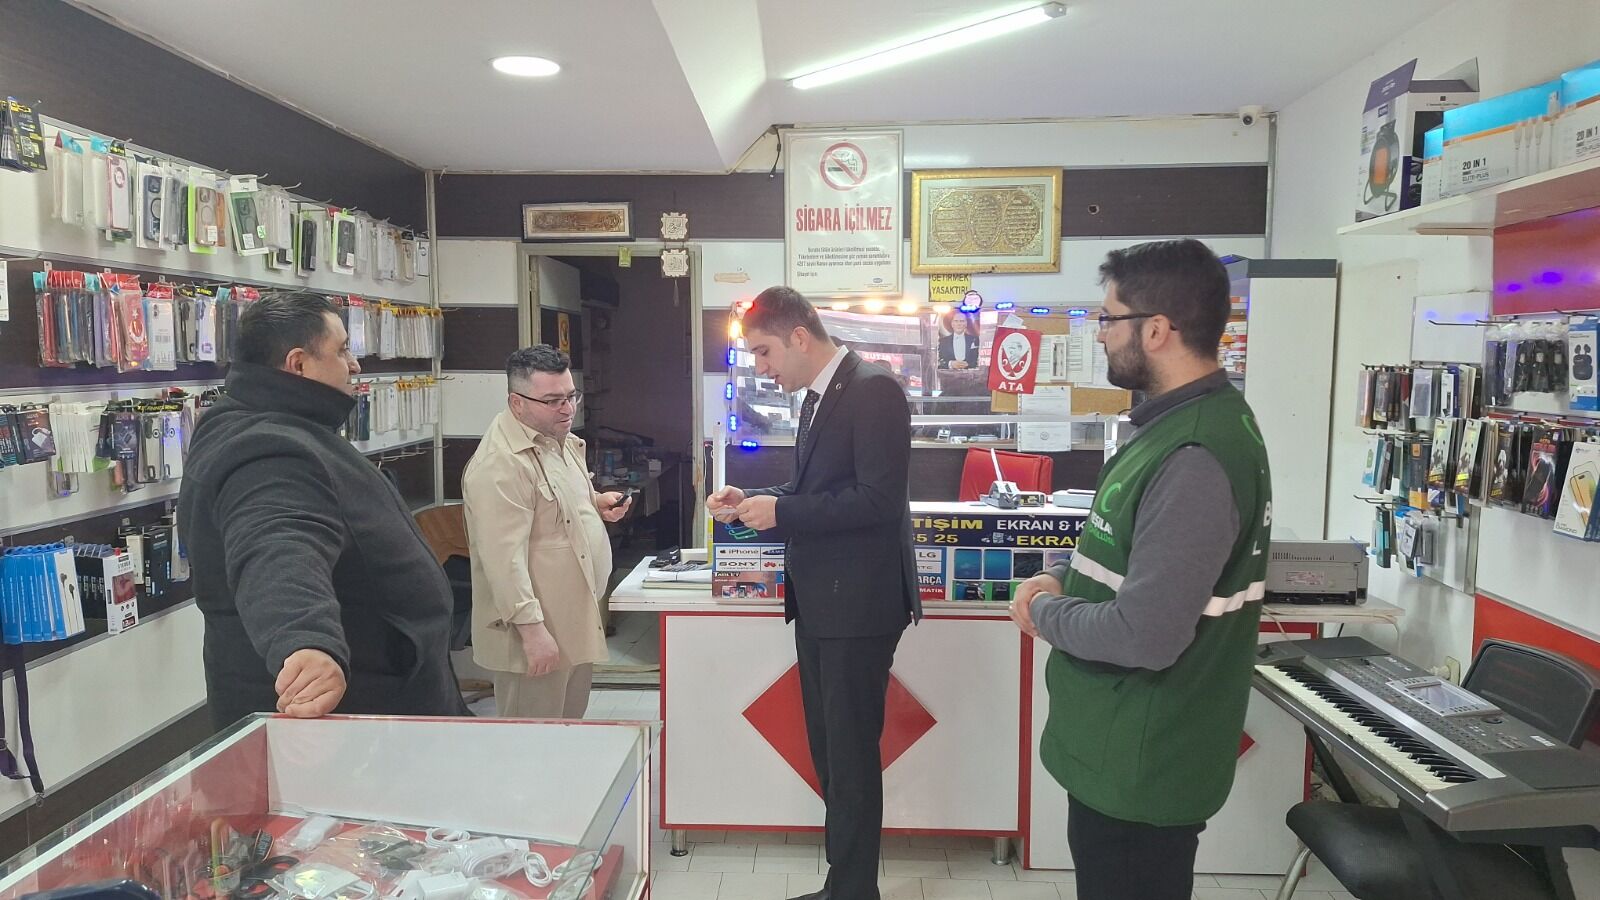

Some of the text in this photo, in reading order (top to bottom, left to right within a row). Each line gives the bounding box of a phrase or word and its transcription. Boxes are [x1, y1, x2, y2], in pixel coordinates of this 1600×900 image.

[1462, 158, 1486, 170] 20 IN 1
[796, 203, 893, 234] SİGARA İÇİLMEZ
[999, 382, 1024, 392] ATA
[997, 520, 1053, 531] EKRAN
[1059, 521, 1070, 530] &
[934, 534, 958, 544] 25
